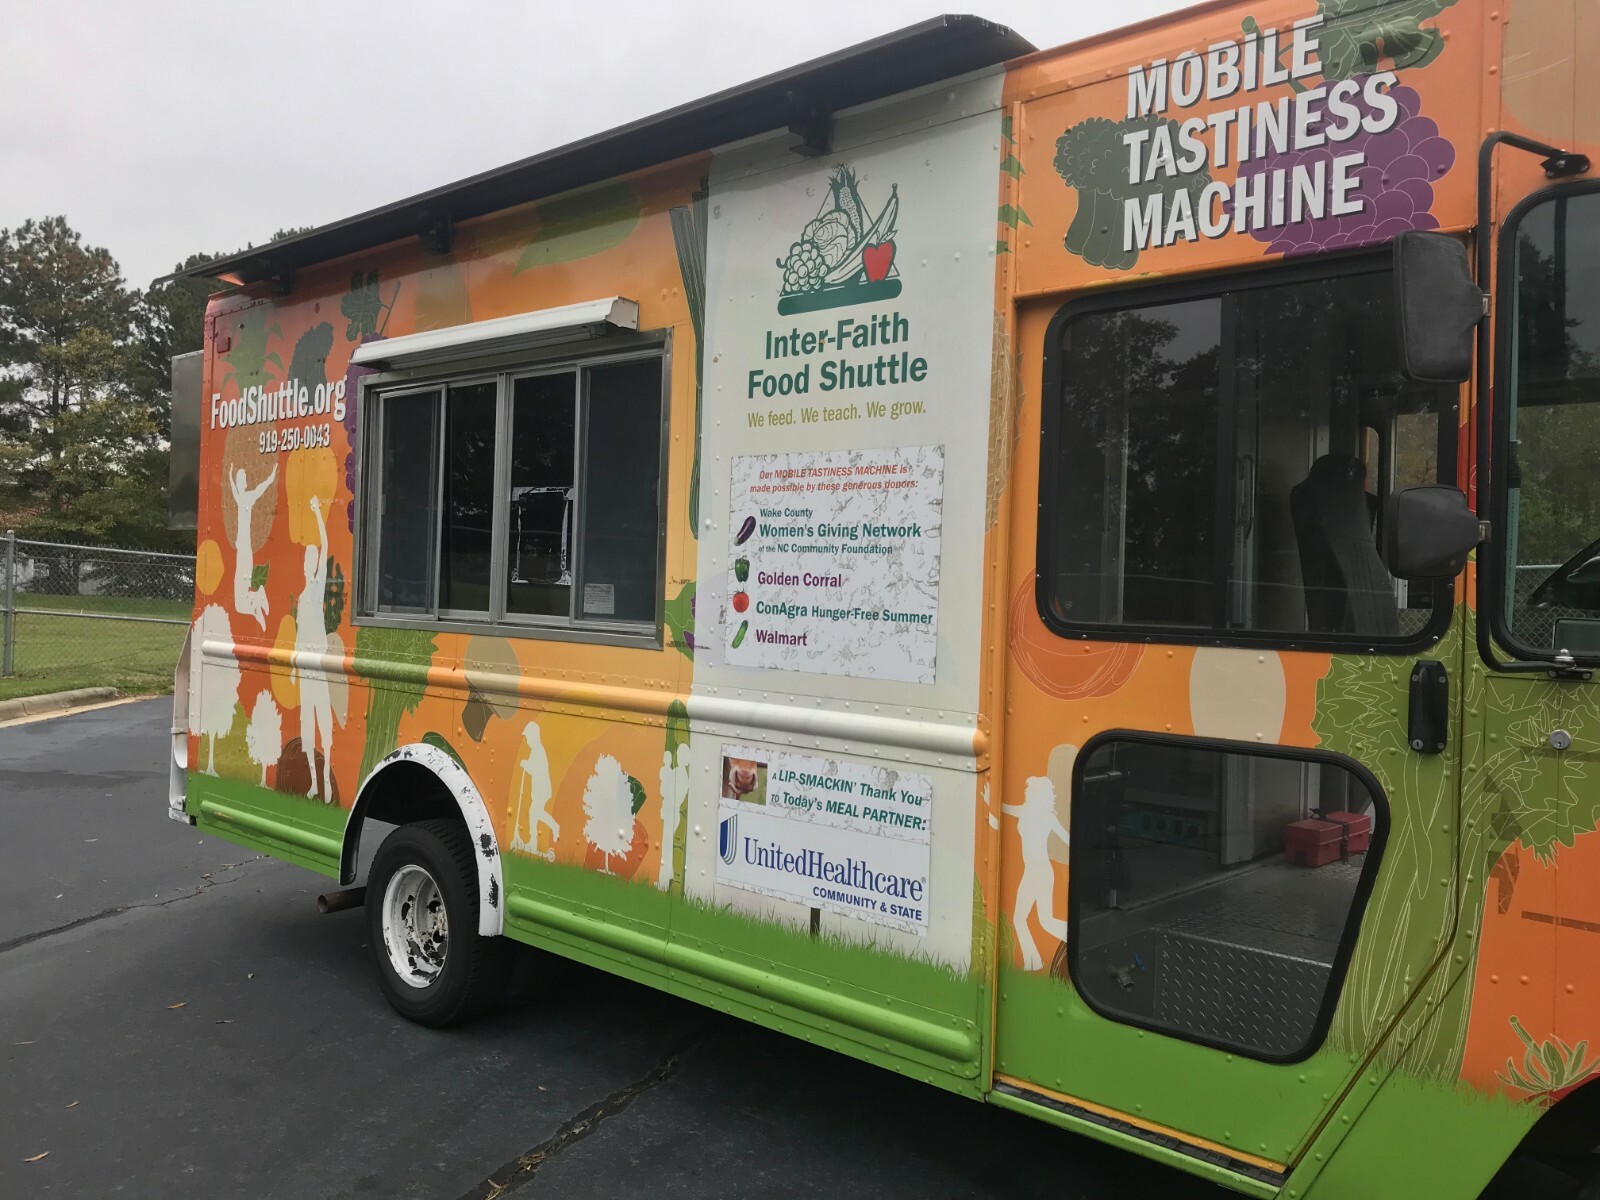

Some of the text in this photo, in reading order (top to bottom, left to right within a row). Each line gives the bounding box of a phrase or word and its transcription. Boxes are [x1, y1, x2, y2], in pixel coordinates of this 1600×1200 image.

[1127, 13, 1324, 119] MOBILE
[1122, 71, 1399, 185] TASTINESS
[1123, 152, 1366, 251] MACHINE
[765, 311, 909, 360] Inter-Faith
[748, 351, 928, 399] Food Shuttle
[211, 375, 347, 430] FoodShuttle.org
[748, 401, 926, 428] We feed. We teach. We grow.
[259, 423, 330, 454] 919-250-0043
[750, 479, 919, 494] made possible by these generous donors:
[759, 464, 908, 480] Our MOBILE TASTINESS MACHINE is
[760, 507, 814, 519] Wake County
[759, 523, 922, 541] Women's Giving Network
[758, 543, 894, 555] of the NC Community Foundation
[758, 571, 842, 588] Golden Corral
[756, 601, 933, 624] ConAgra Hunger-Free Summer
[756, 629, 808, 647] Walmart
[772, 773, 777, 781] A
[860, 783, 897, 802] Thank
[900, 789, 923, 806] You
[783, 792, 823, 811] Today's
[825, 800, 859, 818] MEAL
[862, 807, 927, 831] PARTNER:
[813, 886, 923, 921] COMMUNITY & STATE
